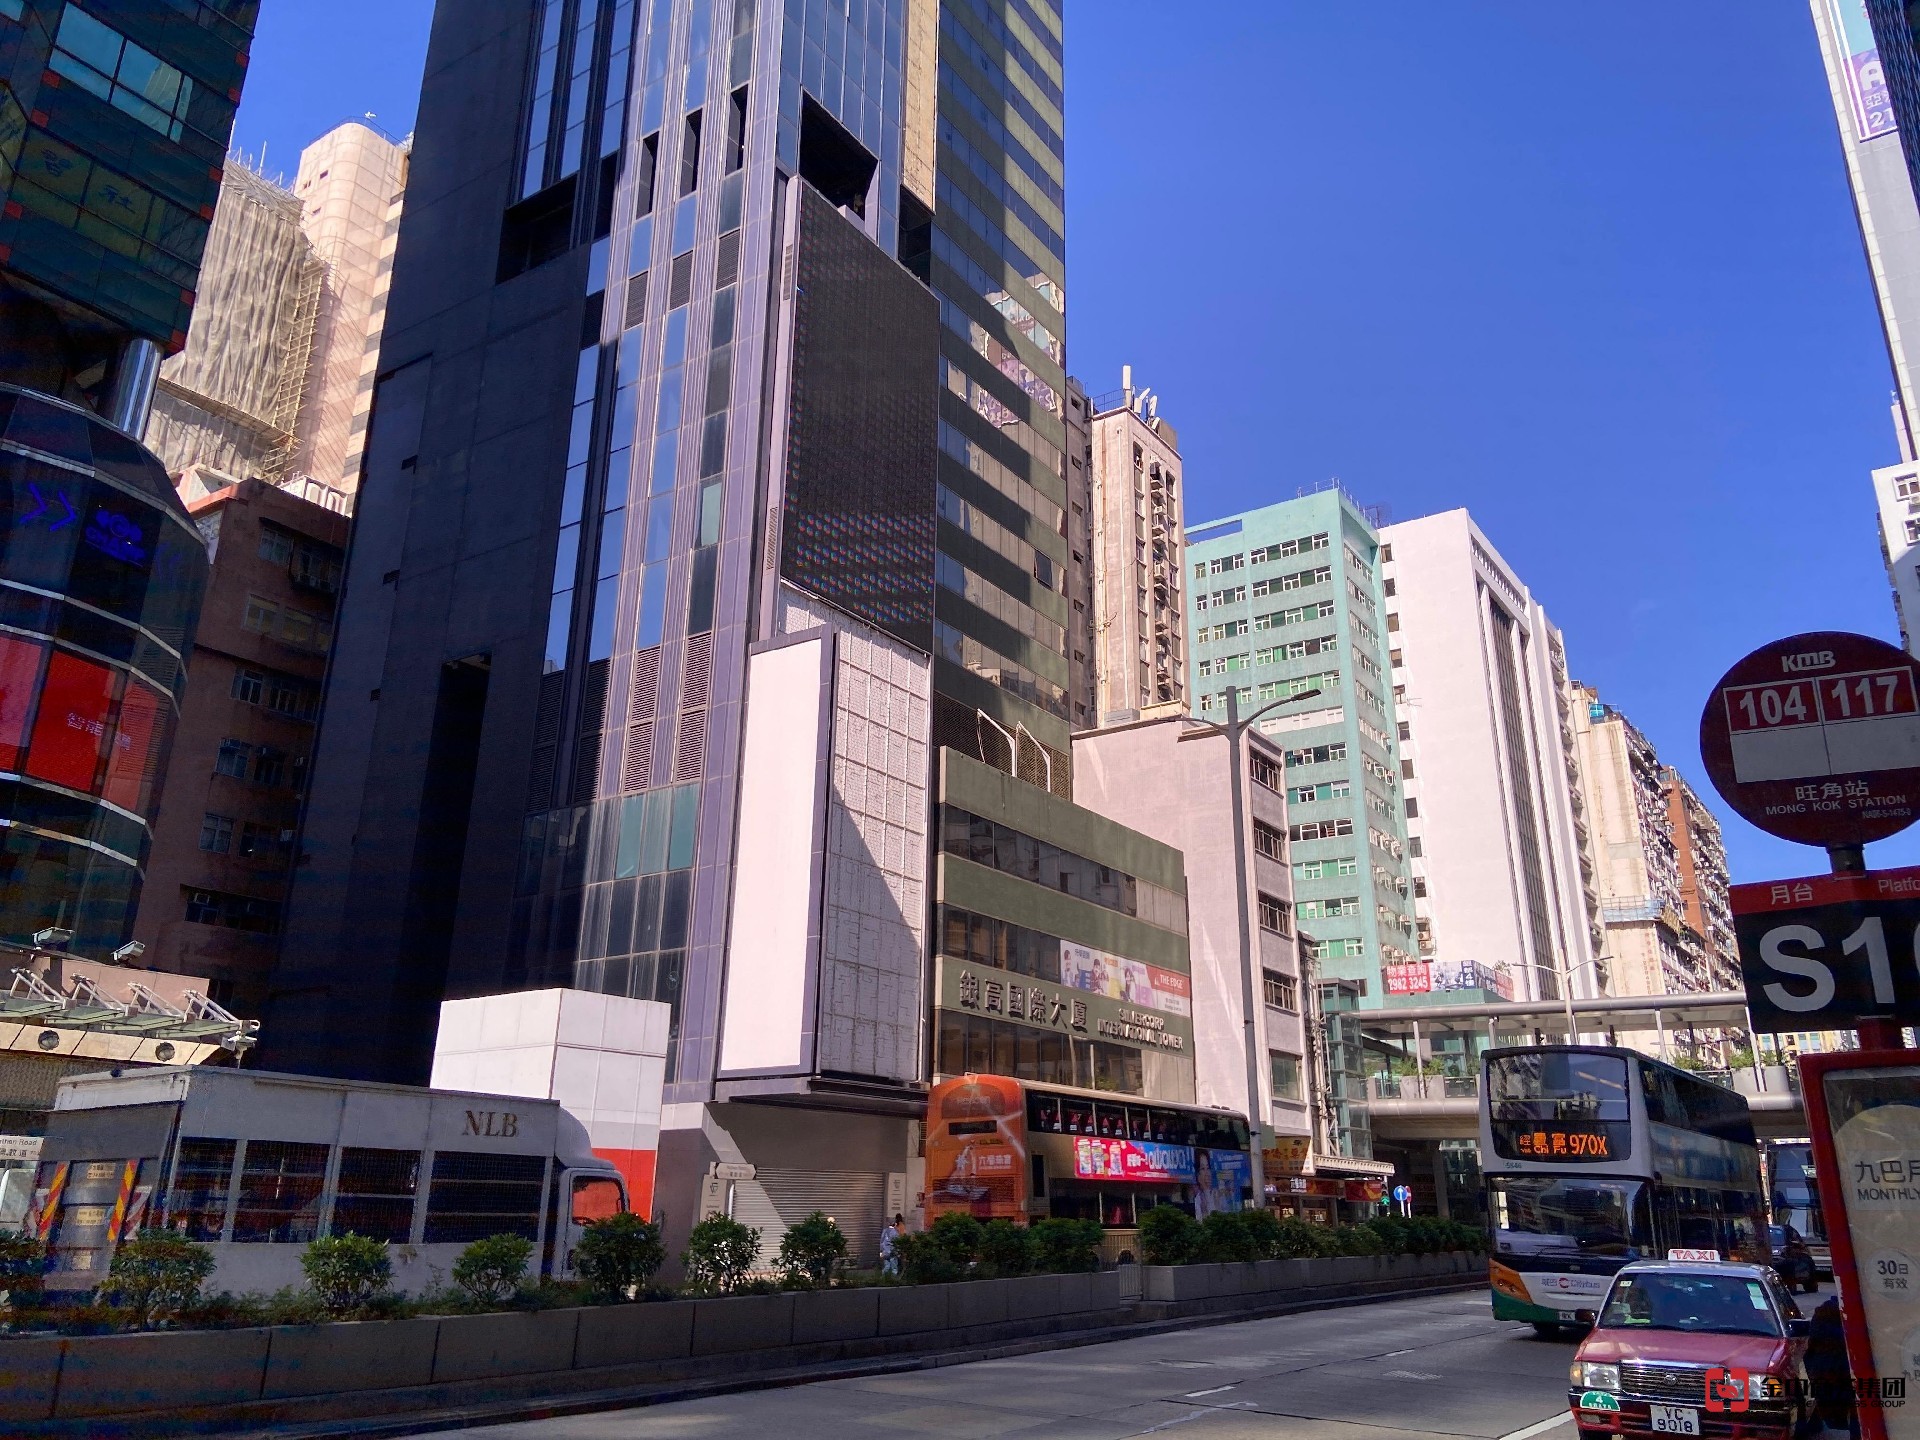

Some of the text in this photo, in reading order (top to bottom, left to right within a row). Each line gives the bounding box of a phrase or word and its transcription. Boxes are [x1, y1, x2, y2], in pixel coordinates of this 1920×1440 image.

[1781, 650, 1836, 673] KMB
[1740, 685, 1807, 726] 104
[1831, 675, 1898, 717] 117
[1795, 780, 1870, 801] 旺角站
[1766, 795, 1907, 816] MONG KOK STATION
[1771, 882, 1814, 905] 月台
[1759, 916, 1920, 1012] S1
[1160, 974, 1184, 990] THE EDGE
[1409, 975, 1428, 990] 3245
[1118, 1008, 1165, 1031] SILVERCORP
[1097, 1018, 1184, 1050] INTERNATIONAL TOWER
[462, 1110, 517, 1137] NLB
[1553, 1145, 1567, 1154] Fu
[1569, 1134, 1608, 1155] 970X
[1672, 1249, 1715, 1261] TAXI
